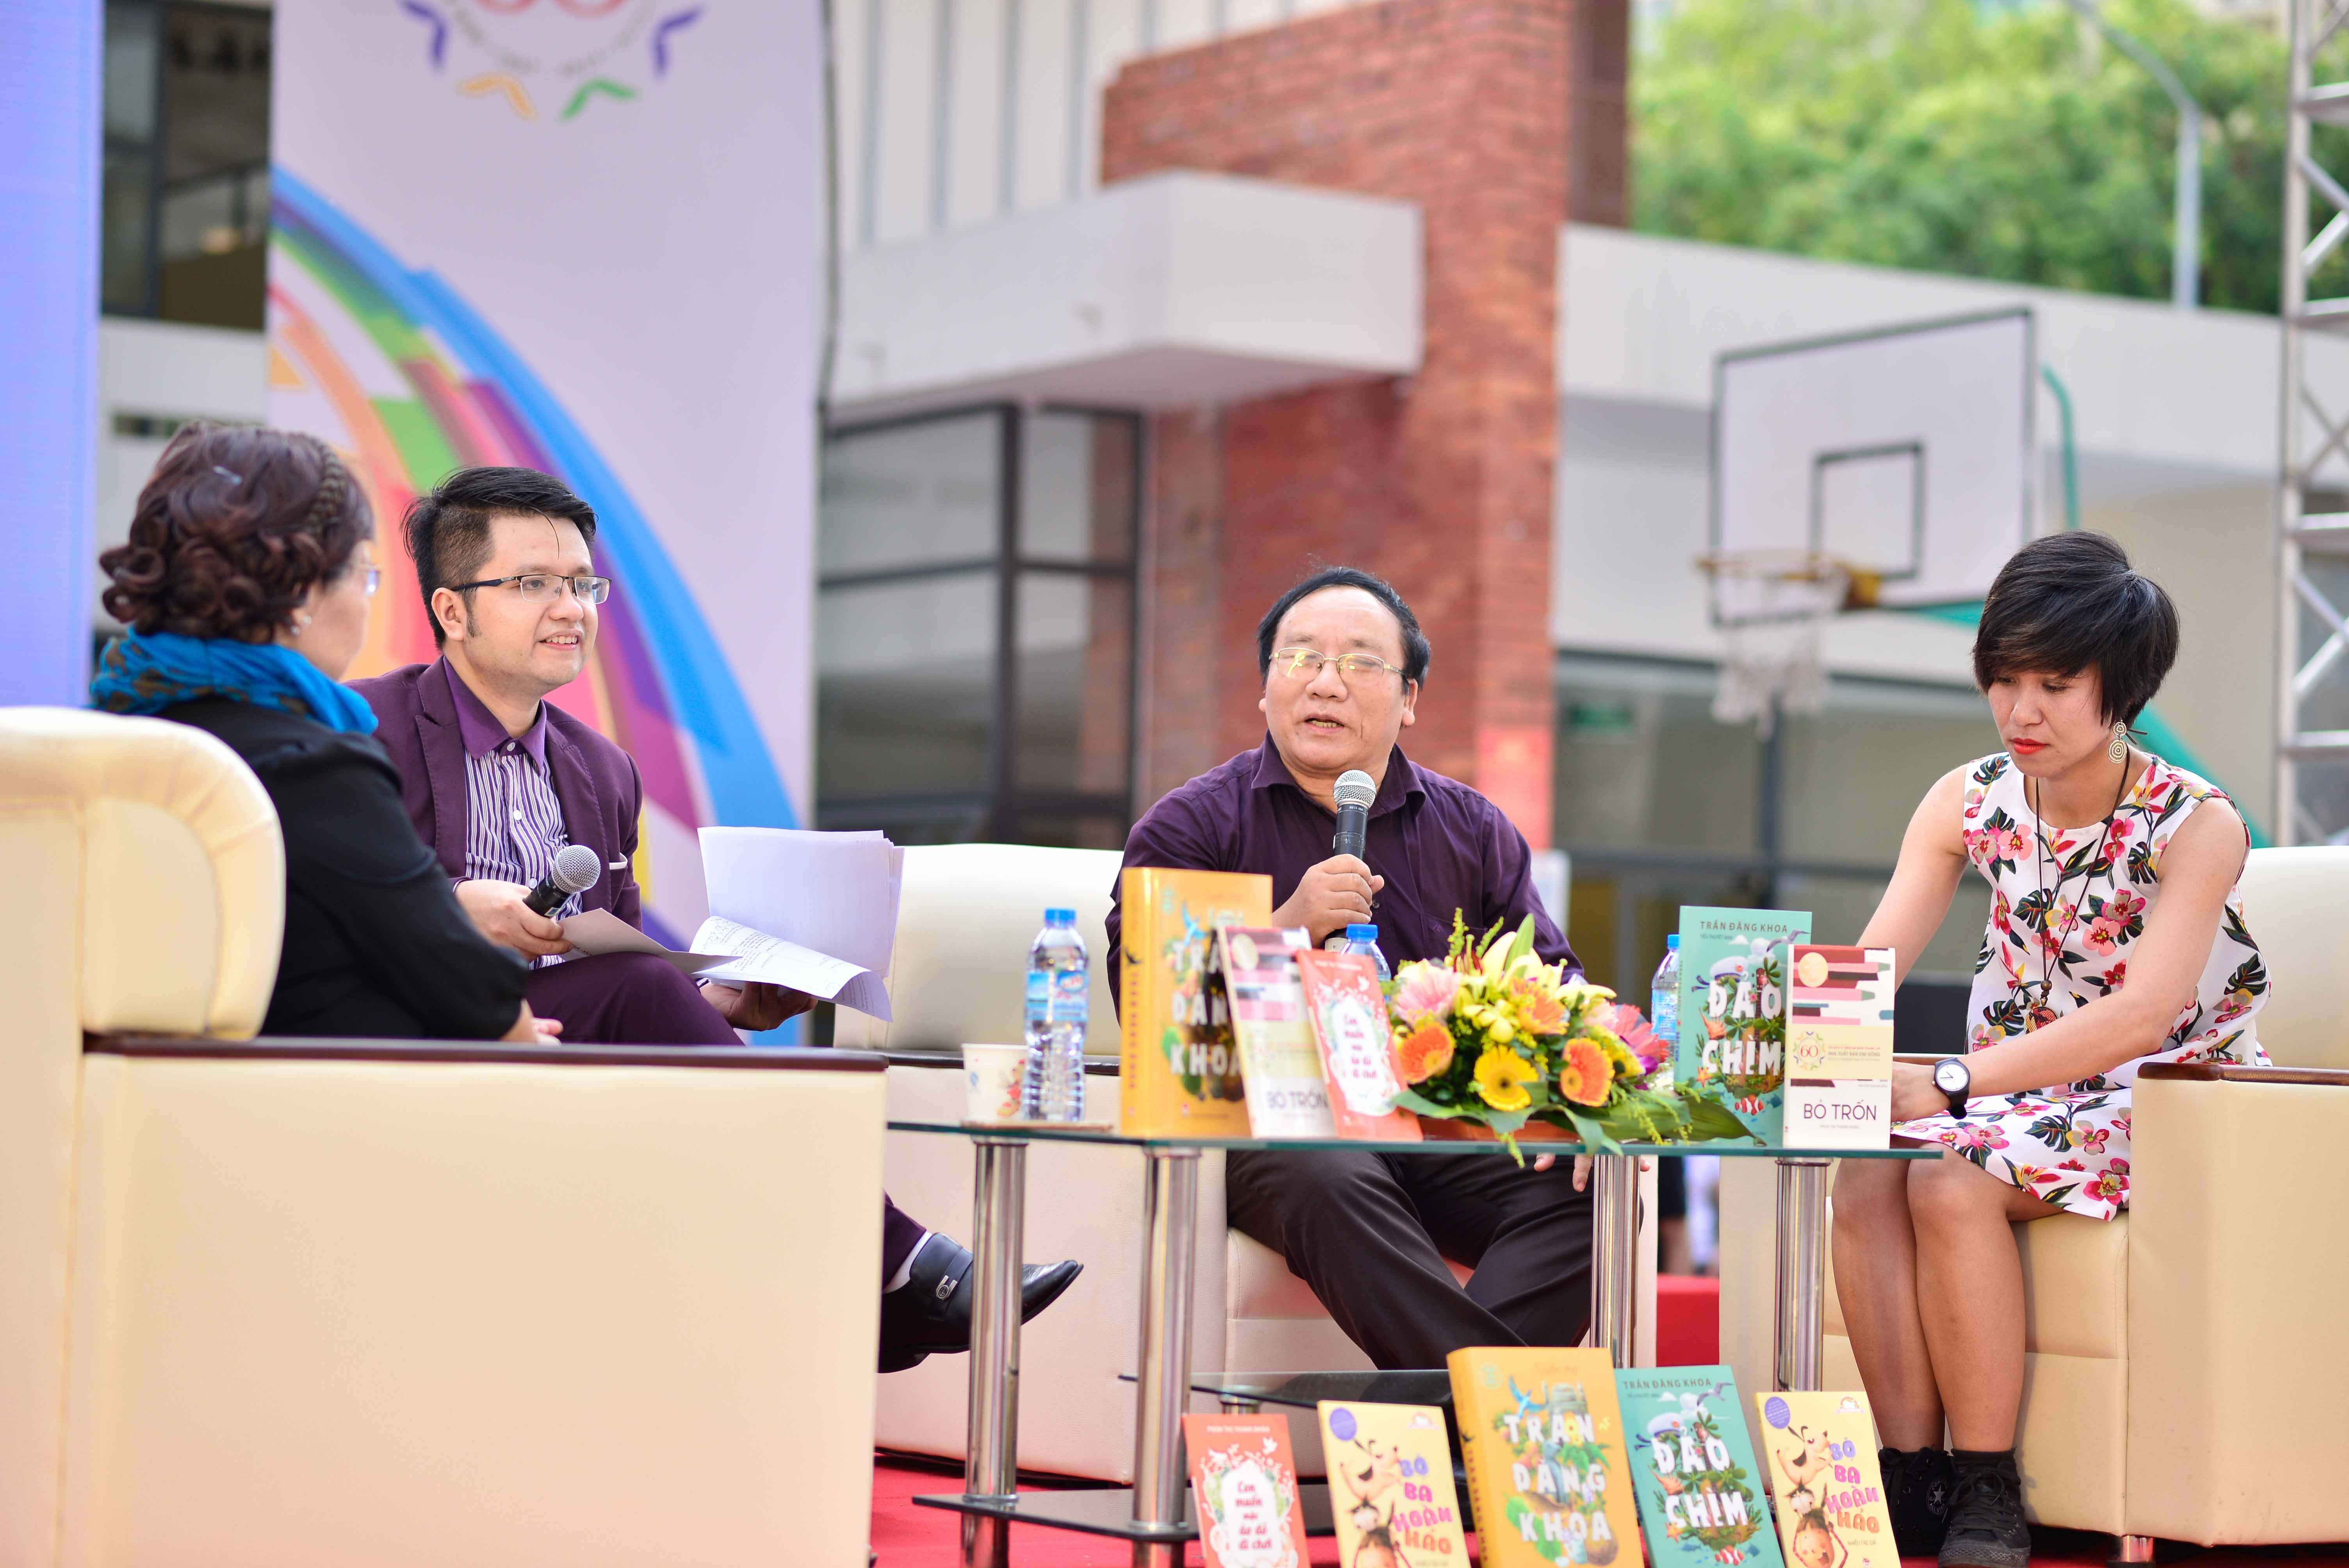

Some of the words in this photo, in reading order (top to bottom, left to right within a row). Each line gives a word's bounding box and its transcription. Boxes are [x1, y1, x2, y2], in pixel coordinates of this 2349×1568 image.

[1760, 924, 1788, 933] KHOA
[1172, 940, 1223, 974] TRA
[1702, 1034, 1782, 1076] CHÌM
[1800, 1044, 1818, 1058] 60
[1804, 1099, 1827, 1119] BỎ
[1831, 1099, 1877, 1120] TRỐN
[1683, 1378, 1712, 1387] KHOA
[1829, 1437, 1856, 1461] BỘ
[1834, 1464, 1861, 1484] BA
[1404, 1482, 1433, 1502] BA
[1824, 1485, 1880, 1514] HOÀN
[1665, 1486, 1749, 1529] CHÌM
[1518, 1510, 1613, 1542] KHOA
[1837, 1508, 1880, 1534] HẢO
